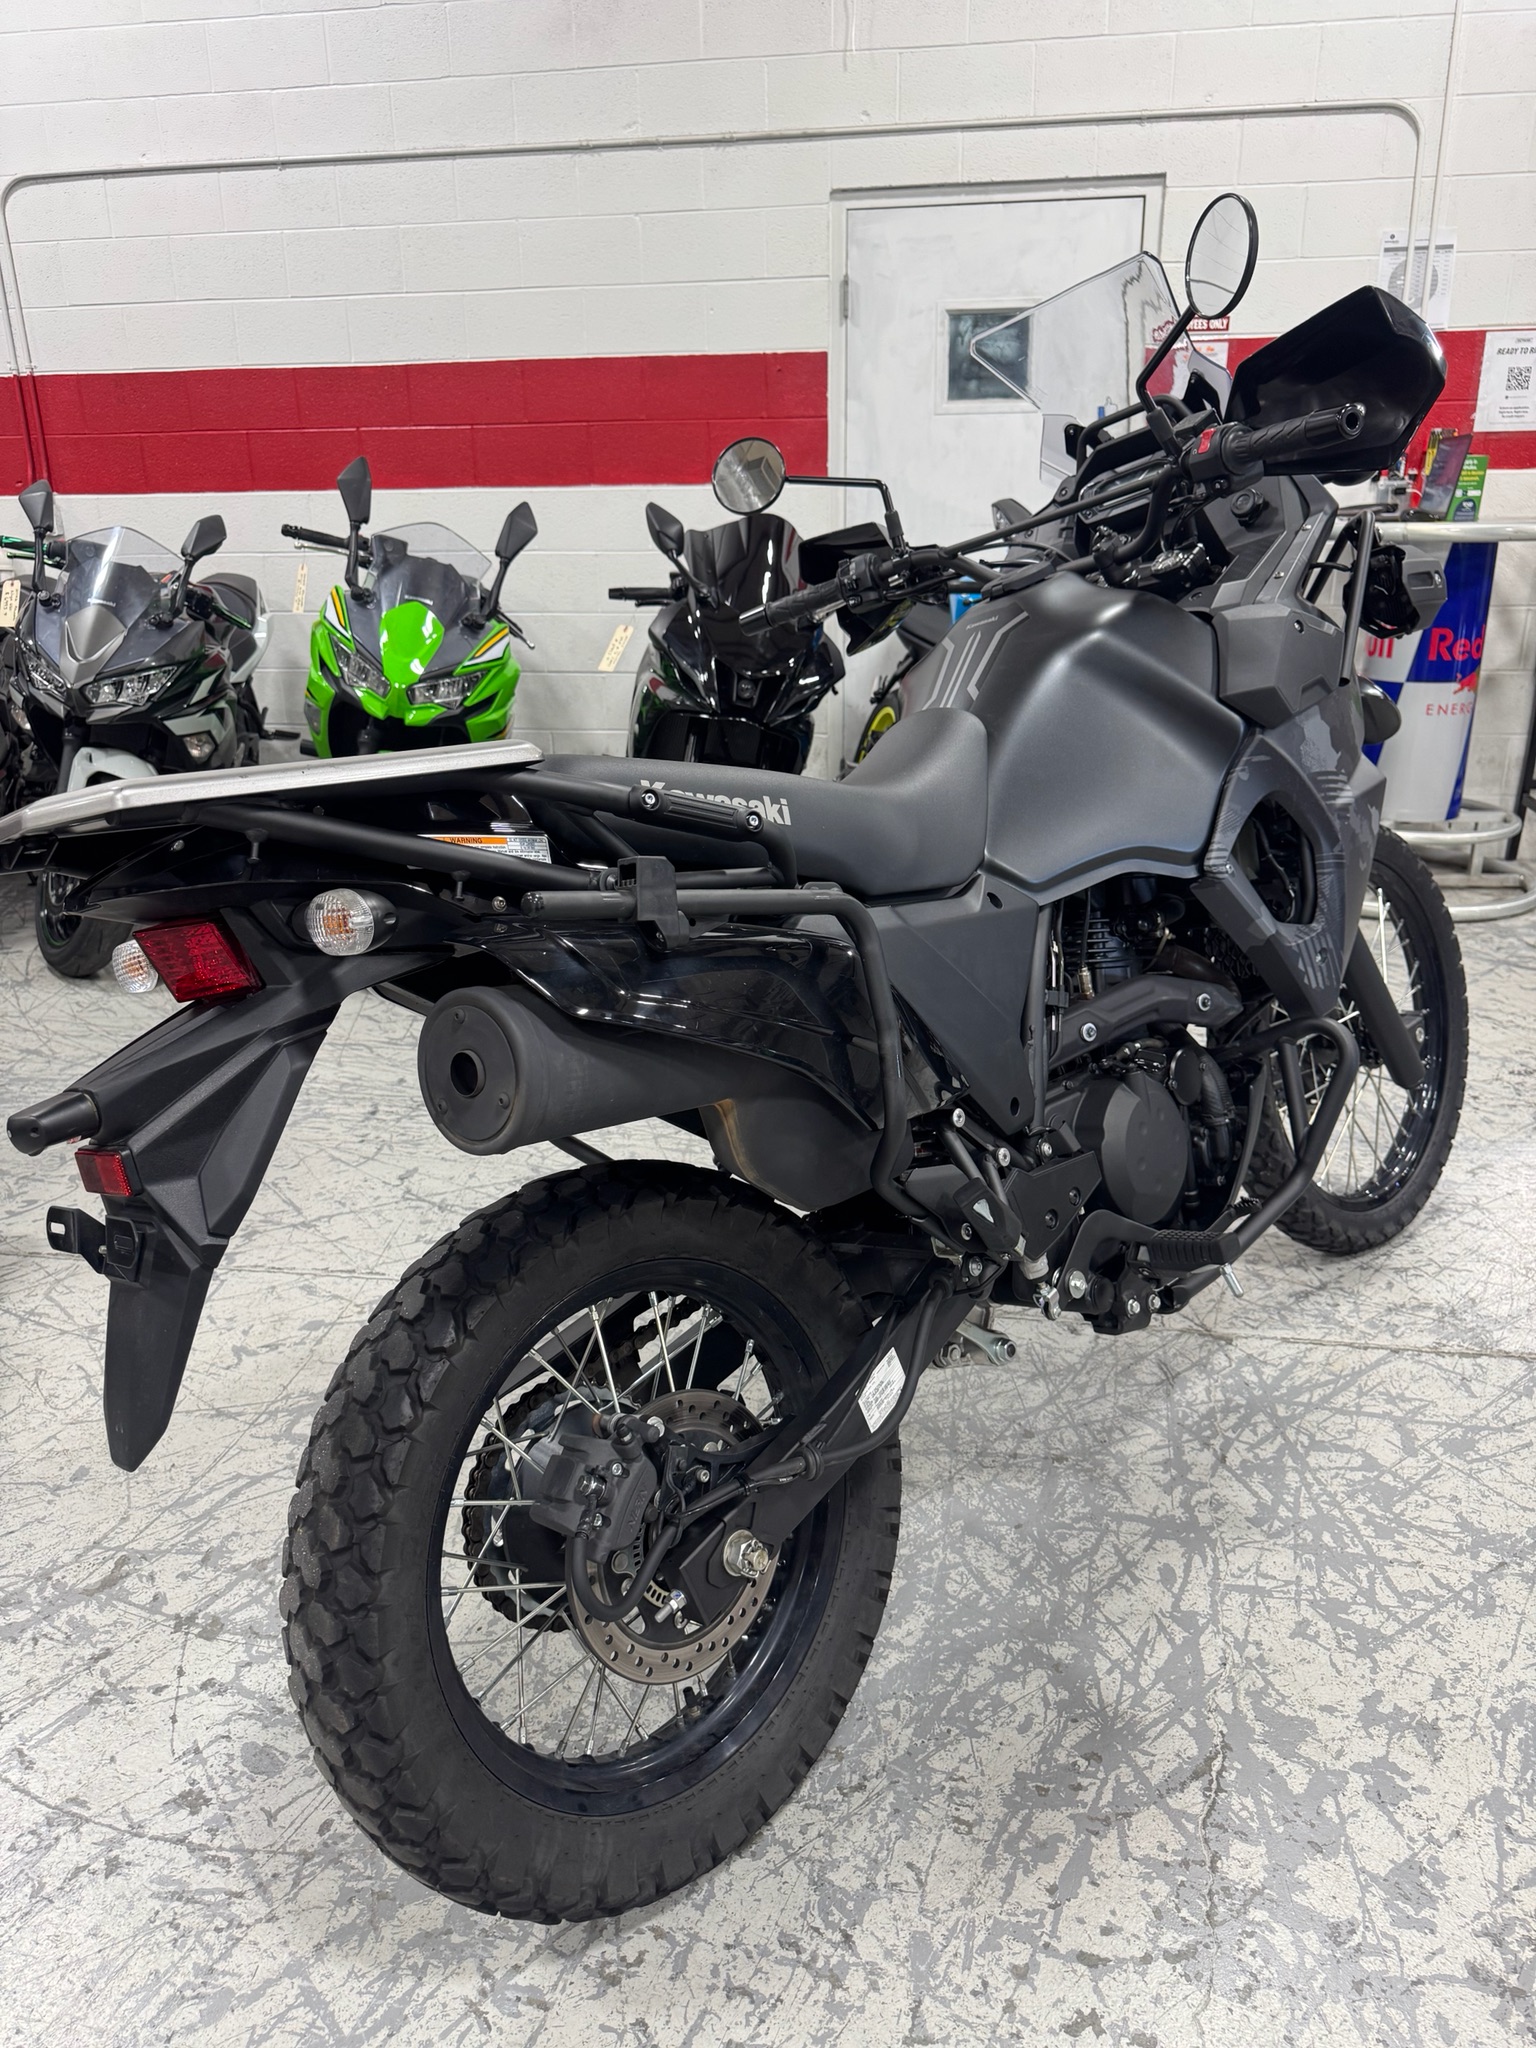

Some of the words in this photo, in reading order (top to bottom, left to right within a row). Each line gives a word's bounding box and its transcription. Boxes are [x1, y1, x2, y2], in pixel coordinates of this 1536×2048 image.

[1496, 347, 1519, 355] READY
[1520, 347, 1529, 355] TO
[1427, 624, 1486, 661] Red
[1425, 701, 1472, 716] ENERG
